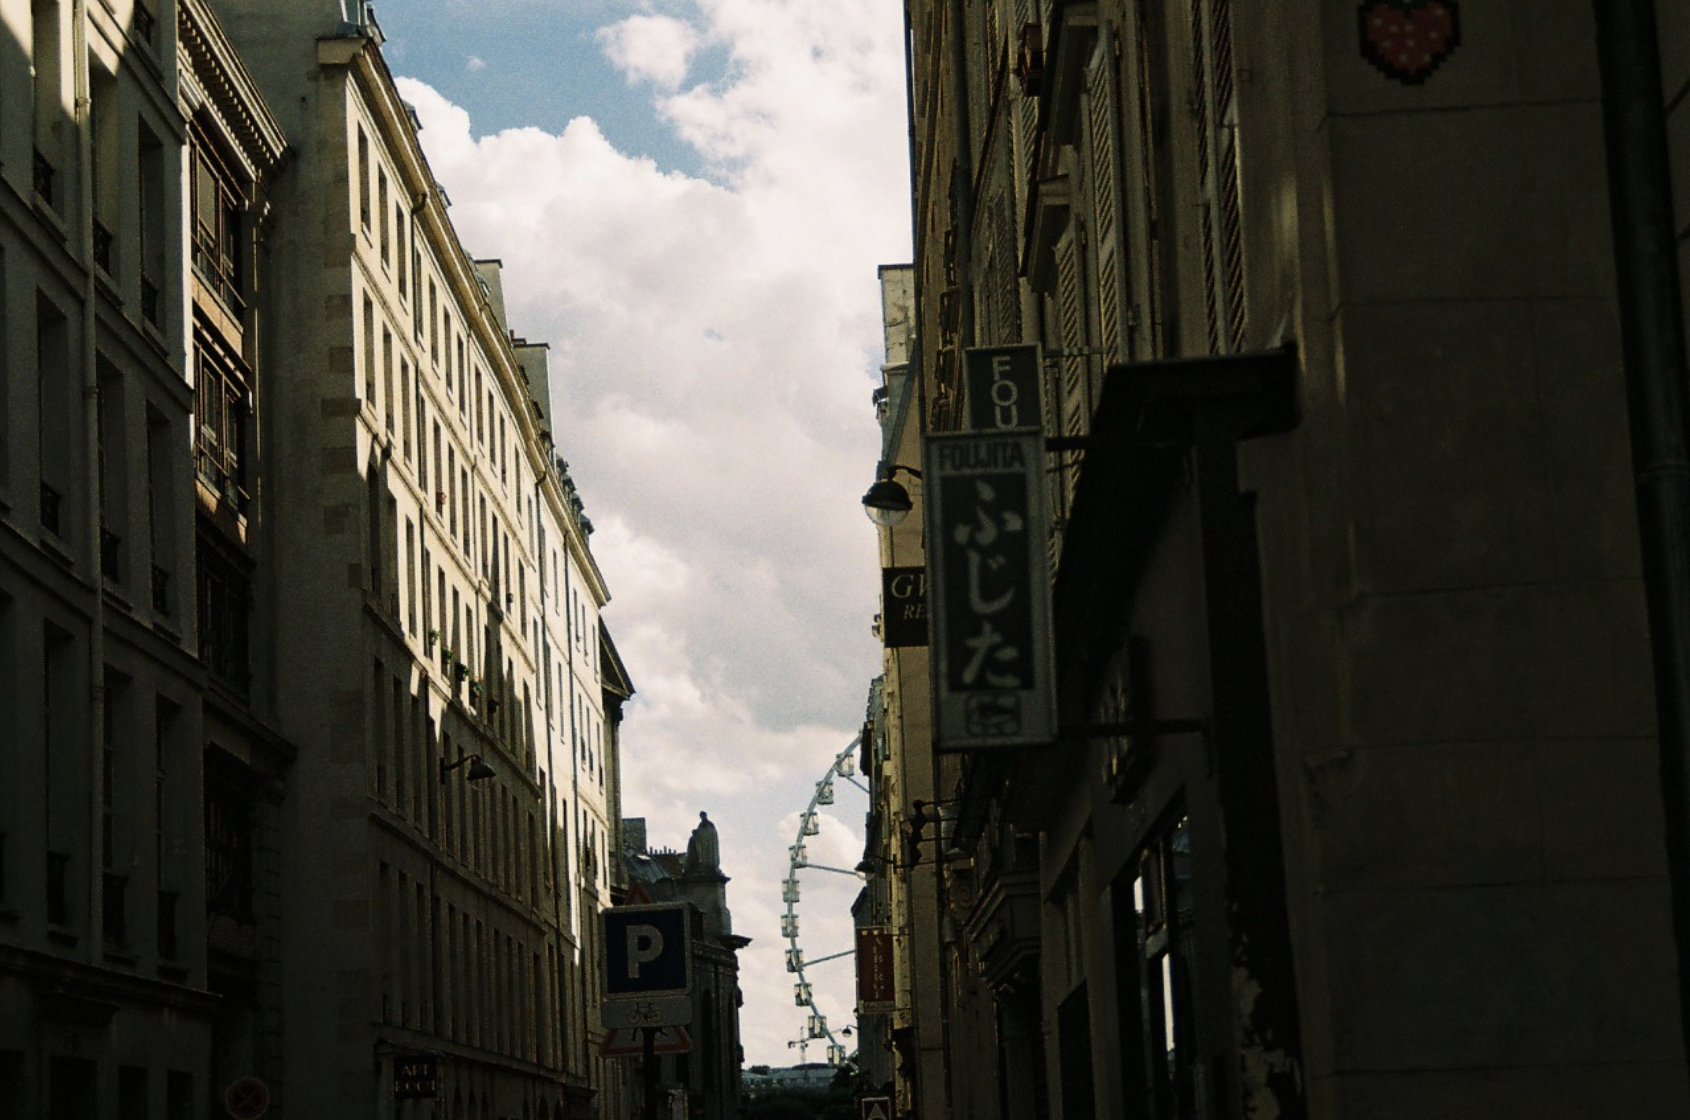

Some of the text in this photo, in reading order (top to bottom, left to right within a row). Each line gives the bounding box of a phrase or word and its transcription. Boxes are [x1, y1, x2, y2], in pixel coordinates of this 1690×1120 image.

[940, 441, 1024, 471] FOUJITA
[953, 479, 1024, 685] ふじた
[626, 924, 664, 979] P
